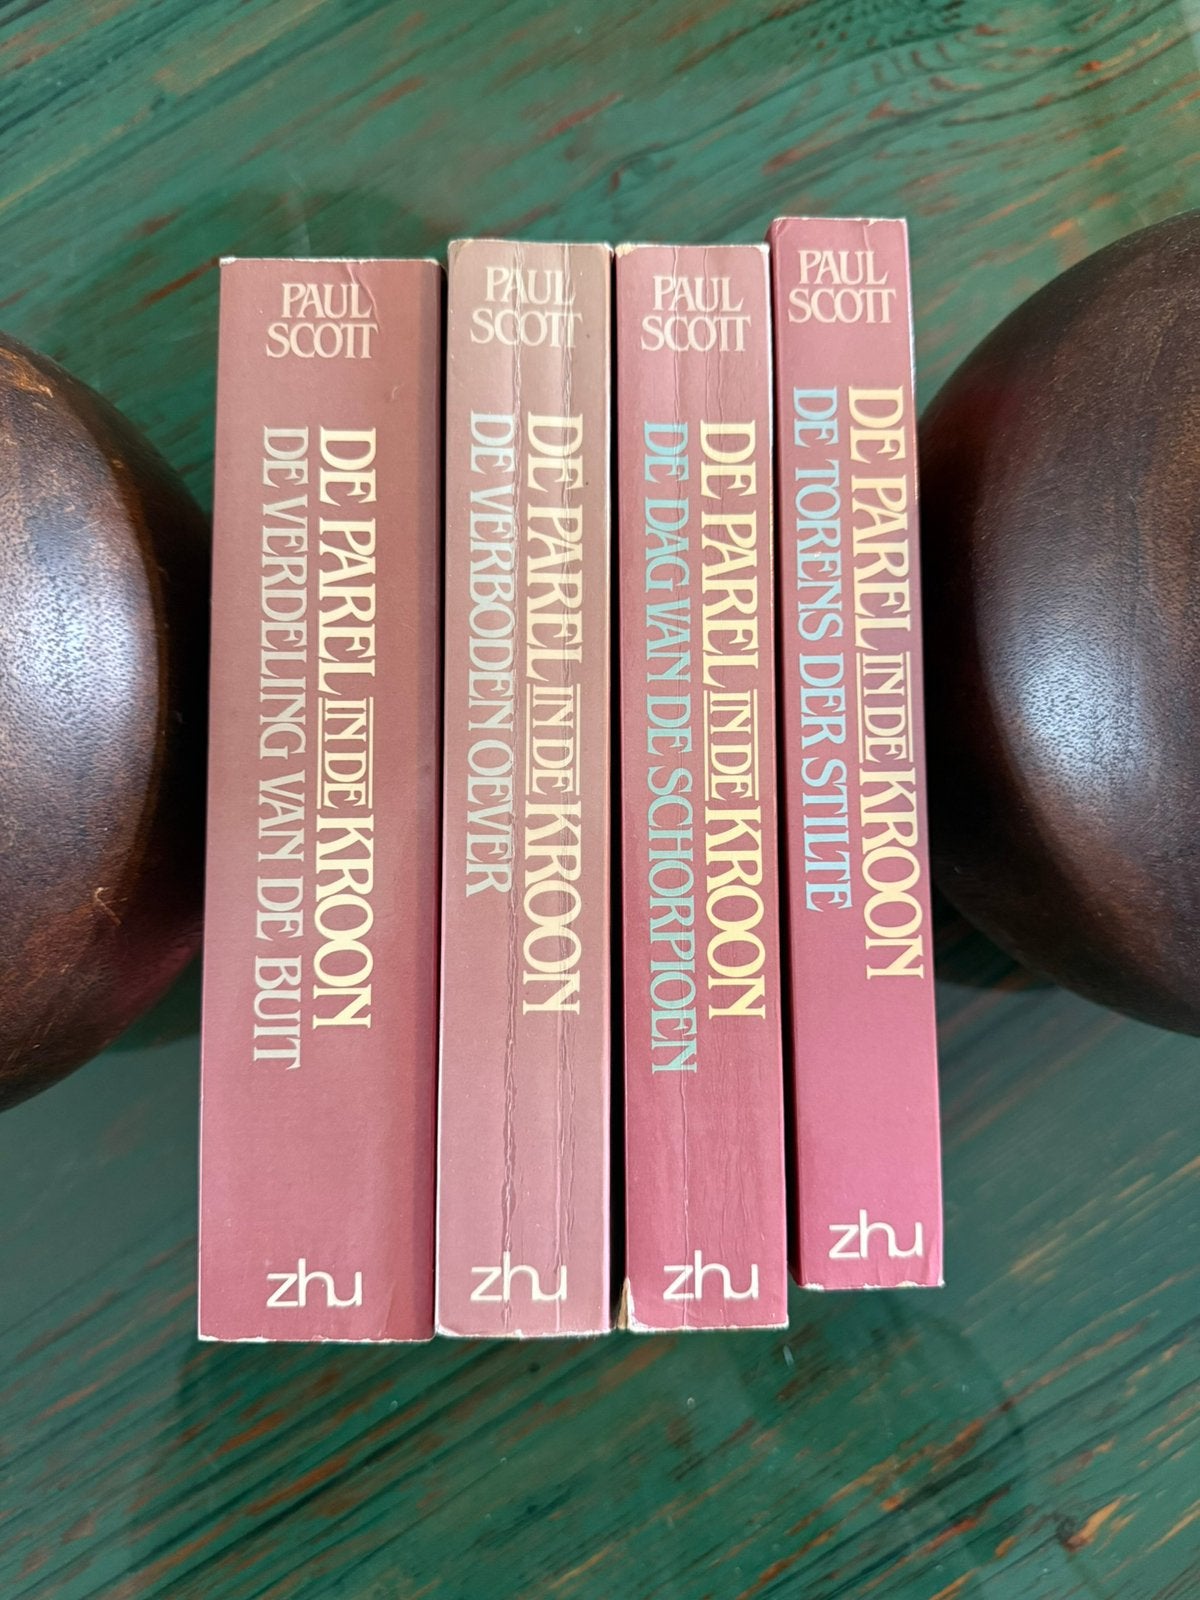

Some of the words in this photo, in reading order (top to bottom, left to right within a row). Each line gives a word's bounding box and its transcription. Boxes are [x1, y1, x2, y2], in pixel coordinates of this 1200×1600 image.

[484, 266, 575, 306] PAUL
[653, 275, 744, 313] PAUL
[798, 249, 889, 287] PAUL
[281, 283, 372, 319] PAUL
[470, 308, 582, 349] SCOTT
[641, 315, 751, 352] SCOTT
[789, 289, 896, 324] SCOTT
[266, 323, 378, 359] SCOTT
[469, 409, 515, 474] DE
[793, 386, 839, 448] DE
[848, 385, 907, 464] DE
[262, 425, 309, 488] DE
[319, 425, 377, 506] DE
[527, 411, 584, 493] DE
[643, 421, 689, 483] DE
[699, 419, 757, 500] DE
[644, 496, 690, 593] DAG
[794, 458, 844, 641] TORENS
[850, 474, 912, 651] PAREL
[317, 517, 376, 695] PAREL
[467, 484, 516, 731] VERBODEN
[526, 503, 583, 682] PAREL
[700, 510, 759, 688] PAREL
[259, 496, 308, 760] VERDELING
[646, 597, 691, 683] VAN
[532, 685, 574, 729] IN
[799, 652, 847, 750] DER
[862, 652, 905, 697] IN
[324, 698, 367, 742] IN
[646, 693, 693, 757] DE
[709, 690, 751, 734] IN
[864, 704, 907, 763] DE
[323, 750, 367, 809] DE
[532, 736, 574, 795] DE
[710, 742, 753, 801] DE
[257, 770, 306, 862] VAN
[465, 739, 515, 897] OEVER
[801, 756, 853, 913] STILTE
[859, 767, 925, 980] KROON
[254, 875, 304, 940] DE
[312, 814, 374, 1029] KROON
[522, 800, 582, 1015] KROON
[647, 765, 698, 1074] SCHORPIOEN
[705, 806, 767, 1019] KROON
[252, 955, 302, 1070] BUIT
[828, 1208, 924, 1259] zhu
[266, 1258, 363, 1308] zhu
[470, 1251, 567, 1302] zhu
[662, 1250, 759, 1301] zhu
